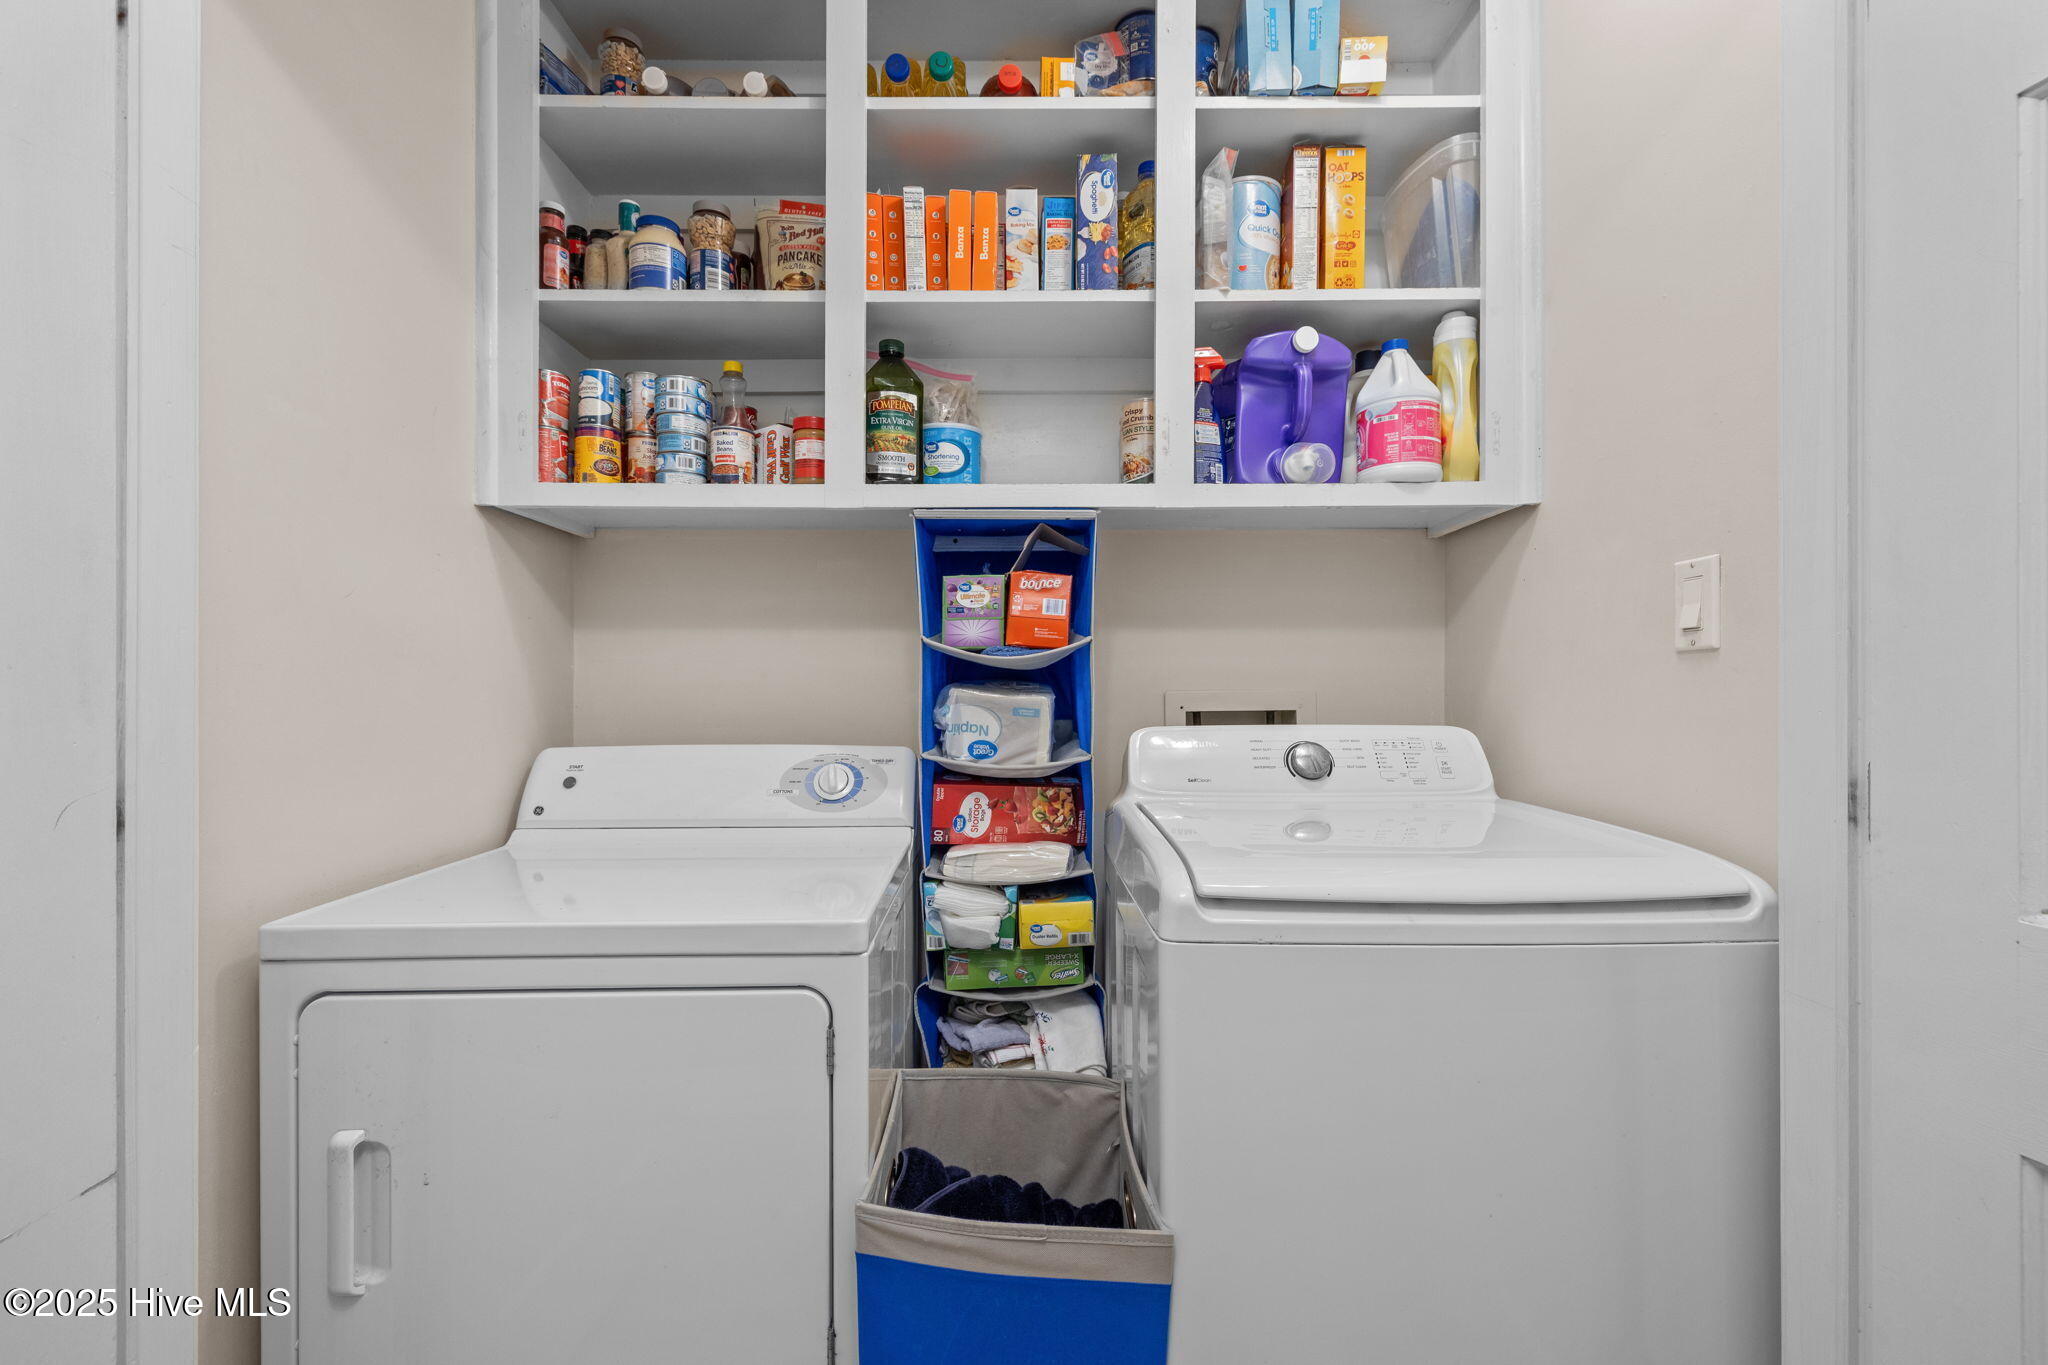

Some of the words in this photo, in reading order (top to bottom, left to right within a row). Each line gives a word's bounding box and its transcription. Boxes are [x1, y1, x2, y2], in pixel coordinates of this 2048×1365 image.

[1328, 162, 1349, 172] OAT
[1328, 172, 1364, 184] HOOPS
[1090, 181, 1098, 214] Spaghetti
[955, 226, 965, 258] Banza
[980, 227, 990, 260] Banza
[777, 250, 823, 267] PANCAKE
[871, 399, 913, 412] POMPEIAN
[1124, 407, 1144, 417] Crispy
[870, 417, 893, 425] EXTRA
[892, 417, 914, 427] VIRGIN
[1130, 415, 1154, 423] Crumb
[1134, 425, 1155, 433] STYLE
[927, 453, 960, 461] Shortening
[1019, 577, 1063, 591] bounce
[947, 721, 989, 737] Napkin
[971, 797, 982, 833] Storage
[933, 829, 943, 842] 80
[1051, 967, 1079, 979] Swiffer
